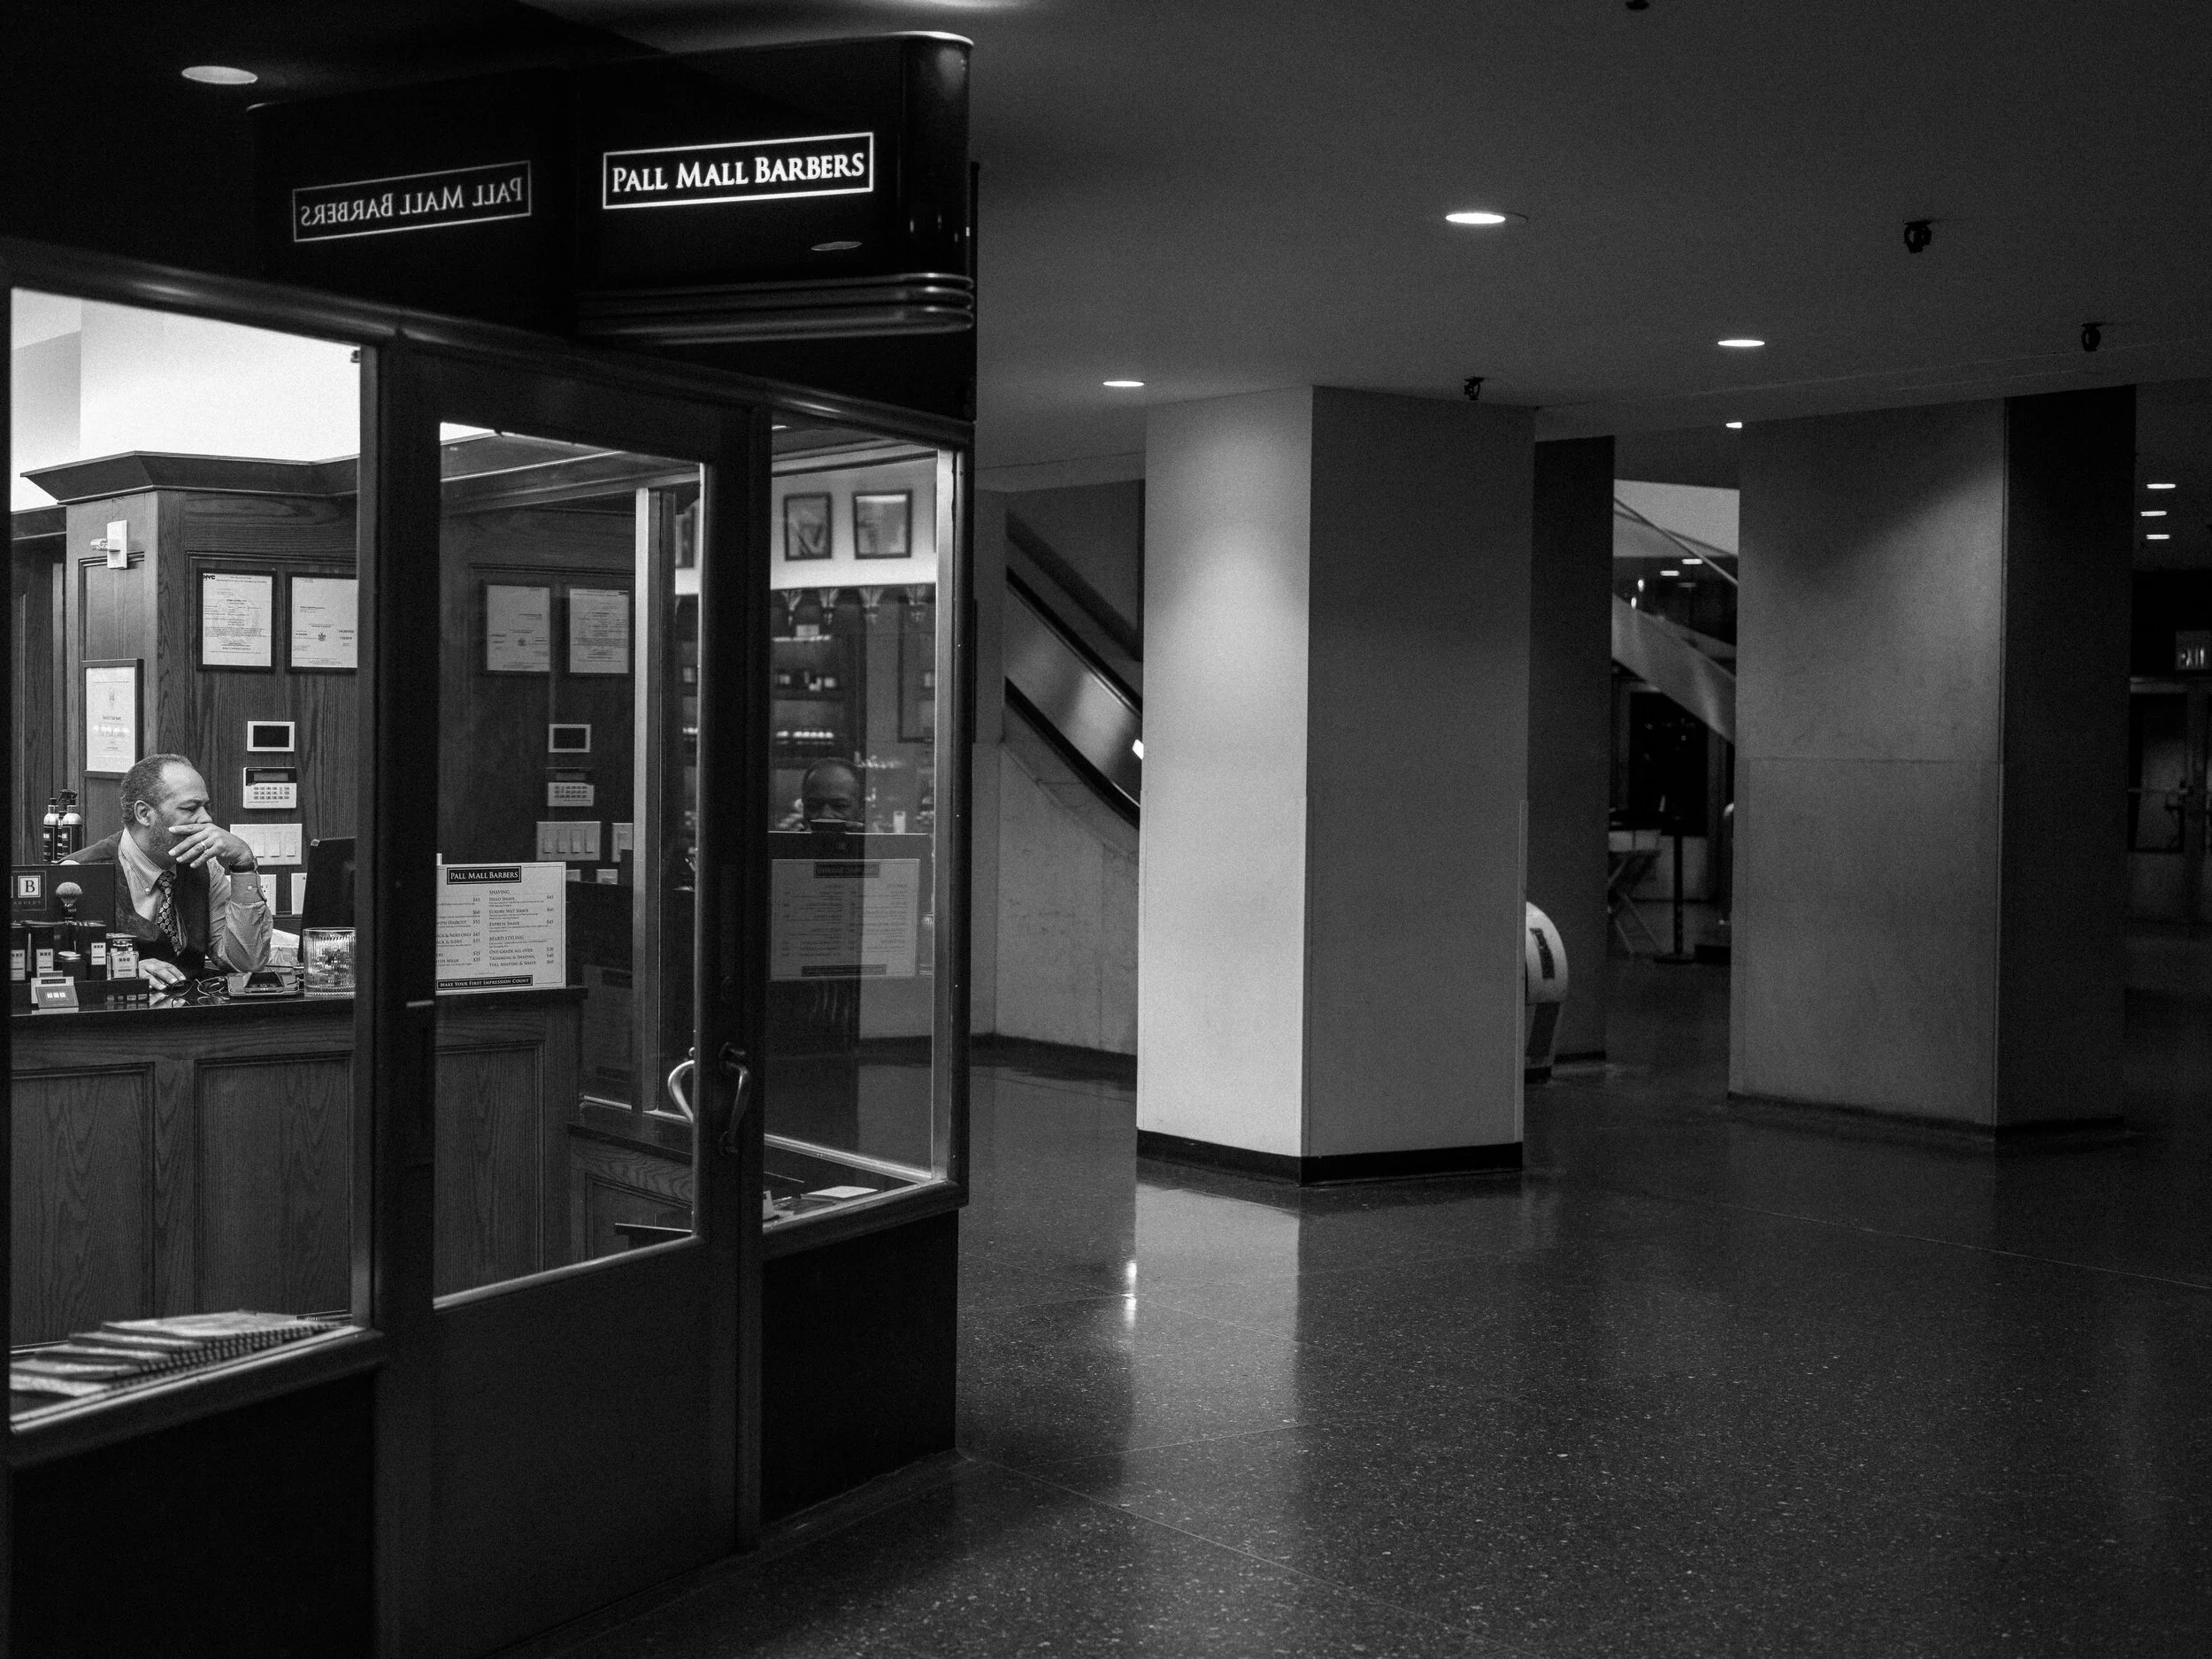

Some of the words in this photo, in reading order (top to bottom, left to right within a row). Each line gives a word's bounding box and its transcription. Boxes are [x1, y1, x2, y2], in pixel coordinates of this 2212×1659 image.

[612, 165, 668, 193] PALL
[676, 159, 749, 188] MALL
[754, 152, 864, 184] BARBERS
[26, 880, 35, 892] B
